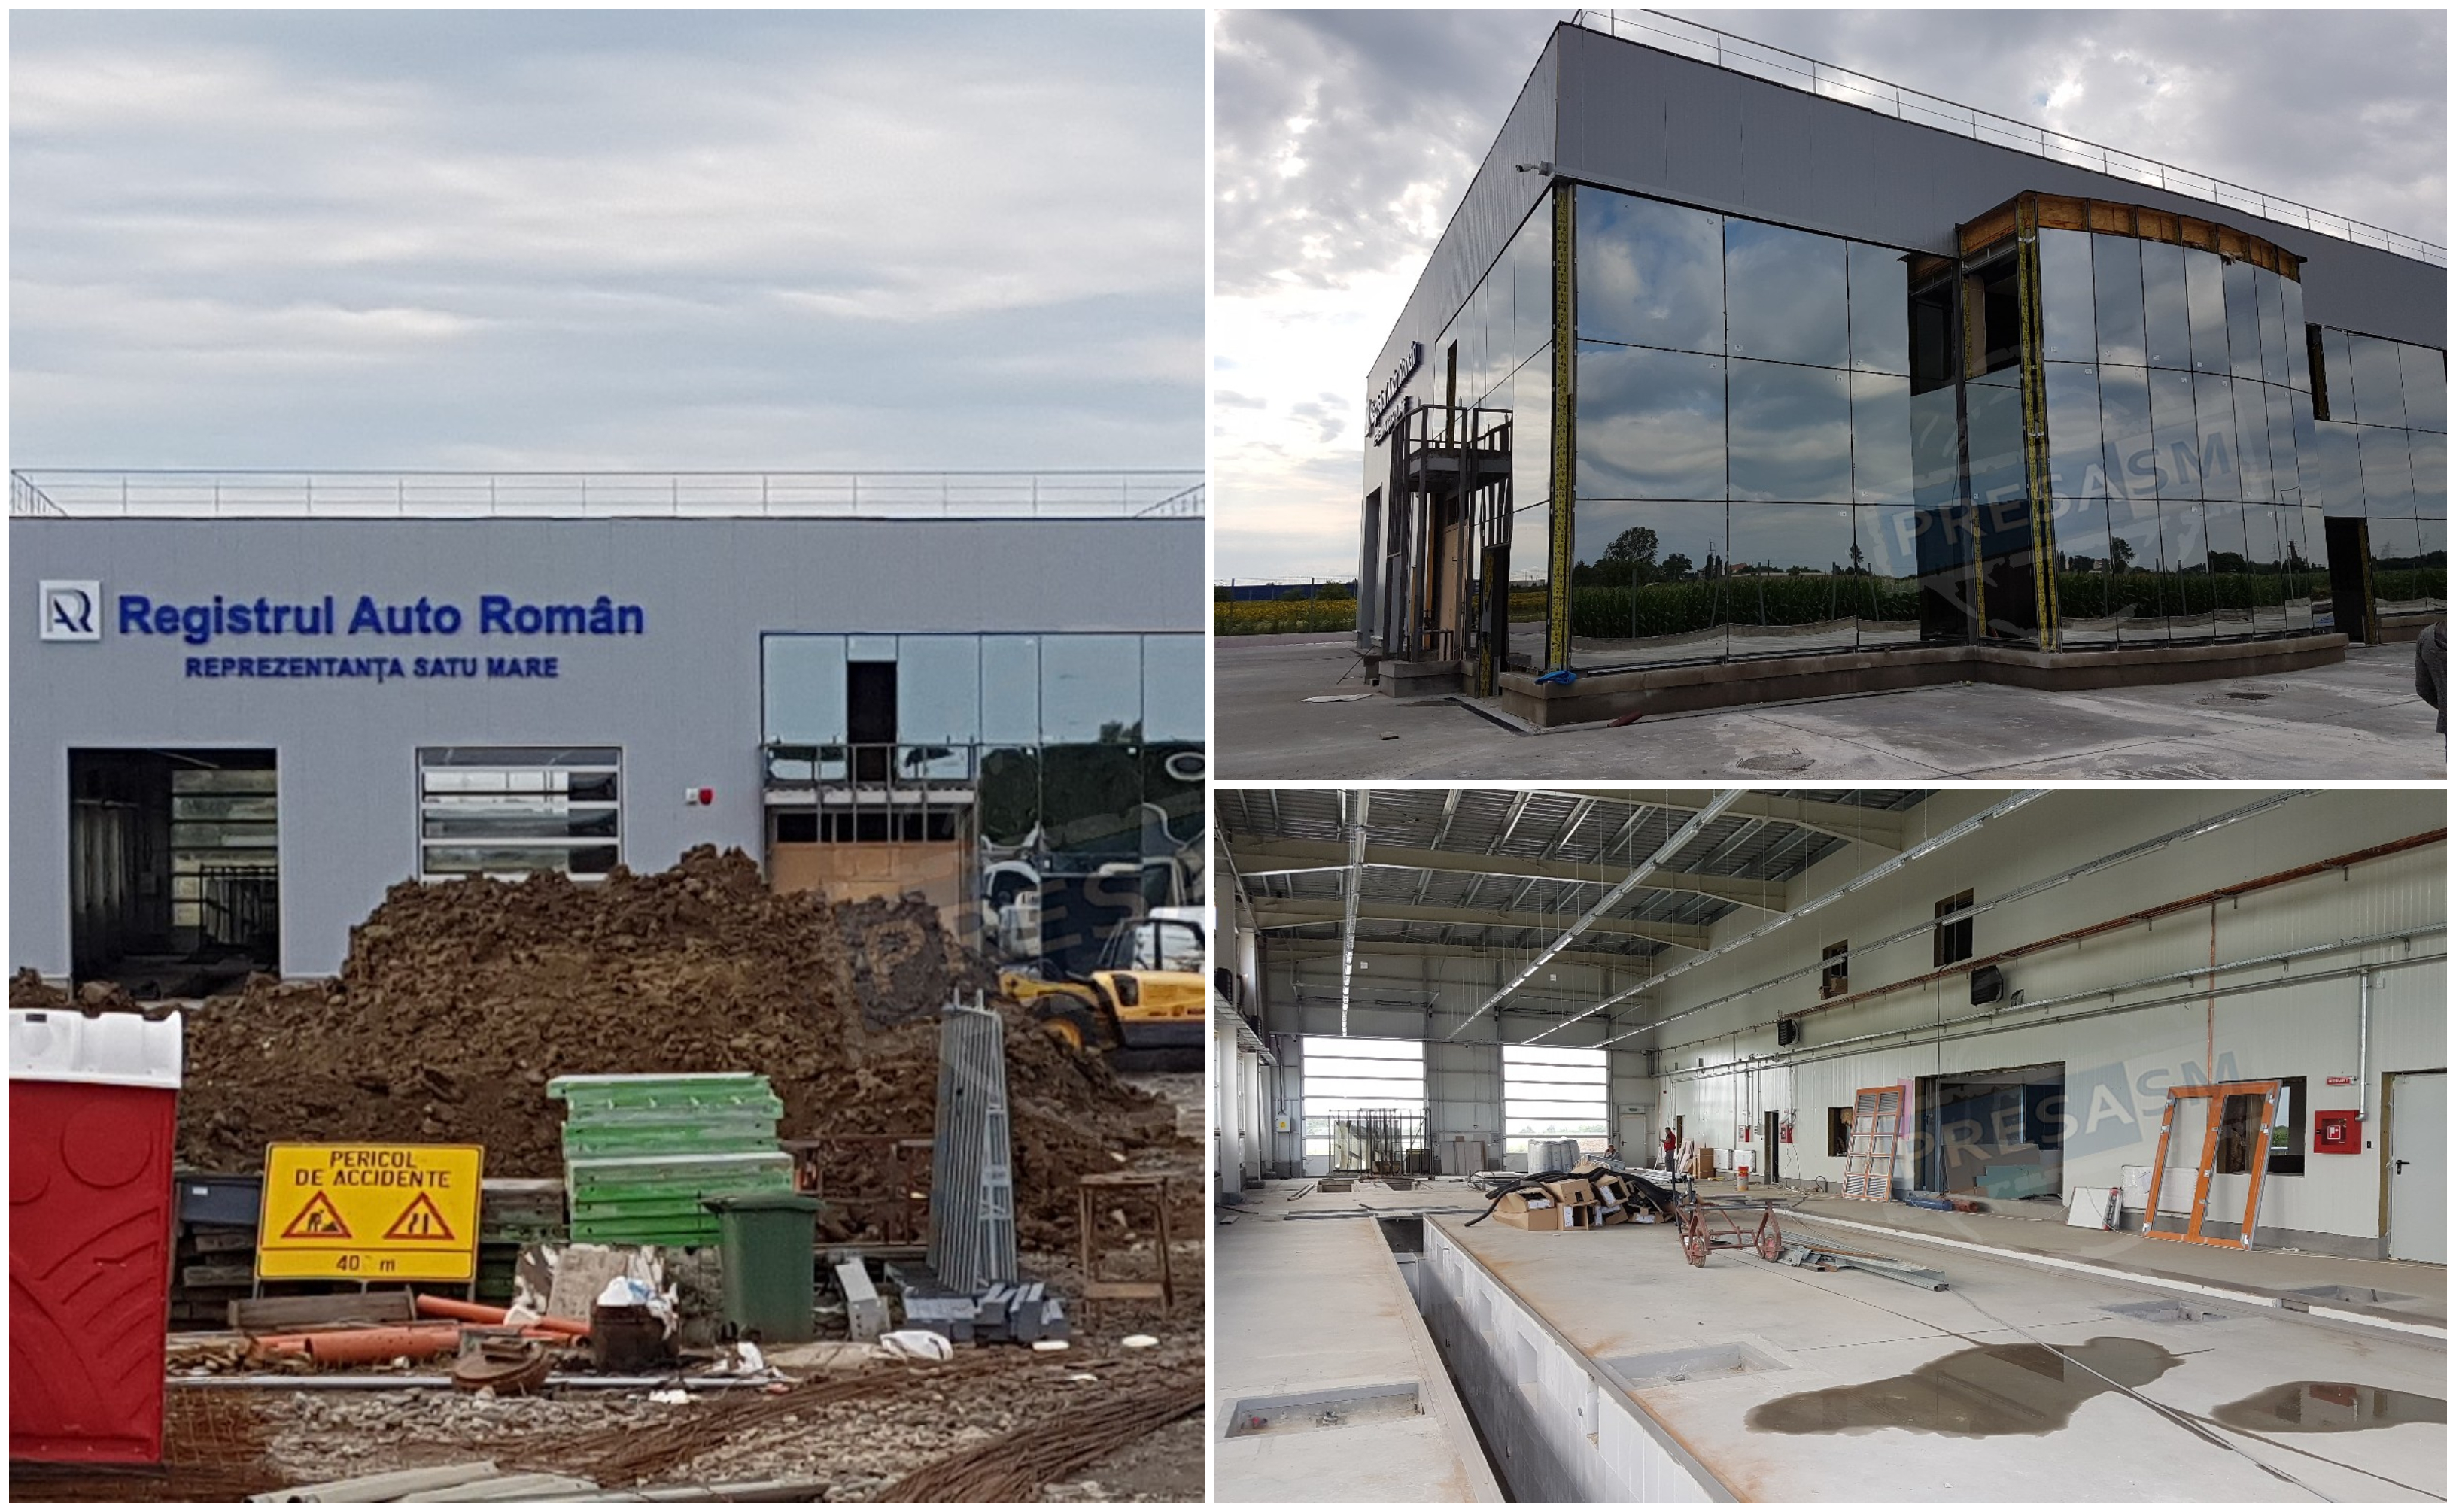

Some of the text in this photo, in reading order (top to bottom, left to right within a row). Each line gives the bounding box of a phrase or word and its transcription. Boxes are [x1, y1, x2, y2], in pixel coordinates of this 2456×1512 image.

[119, 595, 644, 645] Registrul Auto Român
[185, 657, 559, 683] REPREZENTANȚA SATU MARE
[330, 1151, 418, 1168] PERICOL
[296, 1169, 451, 1188] DE ACCIDENTE
[337, 1255, 360, 1271] 40
